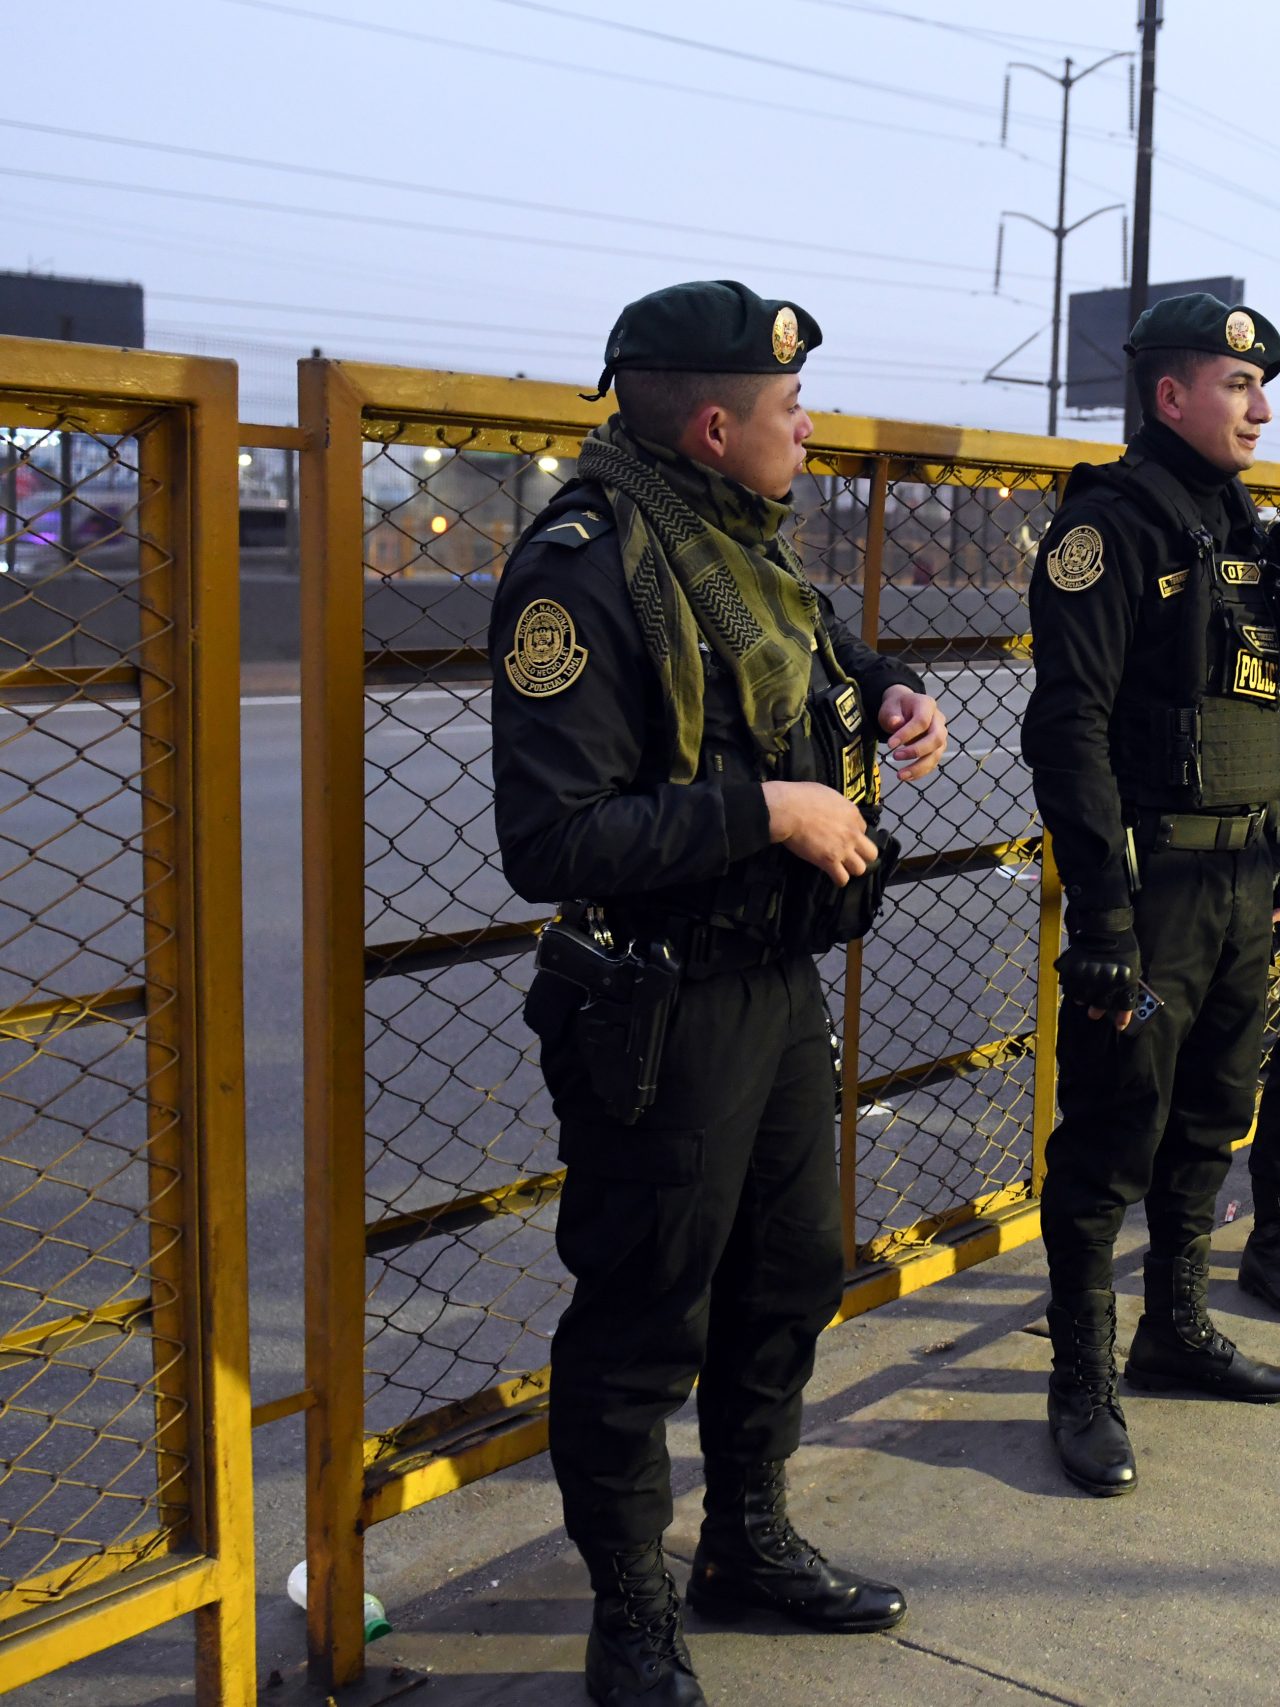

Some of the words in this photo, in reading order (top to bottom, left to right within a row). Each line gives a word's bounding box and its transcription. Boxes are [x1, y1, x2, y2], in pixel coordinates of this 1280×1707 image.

[518, 608, 538, 639] POLICIA
[539, 604, 571, 634] NACIONAL
[528, 676, 567, 692] POLICIAL
[563, 657, 582, 678] LIMA
[536, 661, 562, 677] HECHO
[559, 646, 570, 661] LEY
